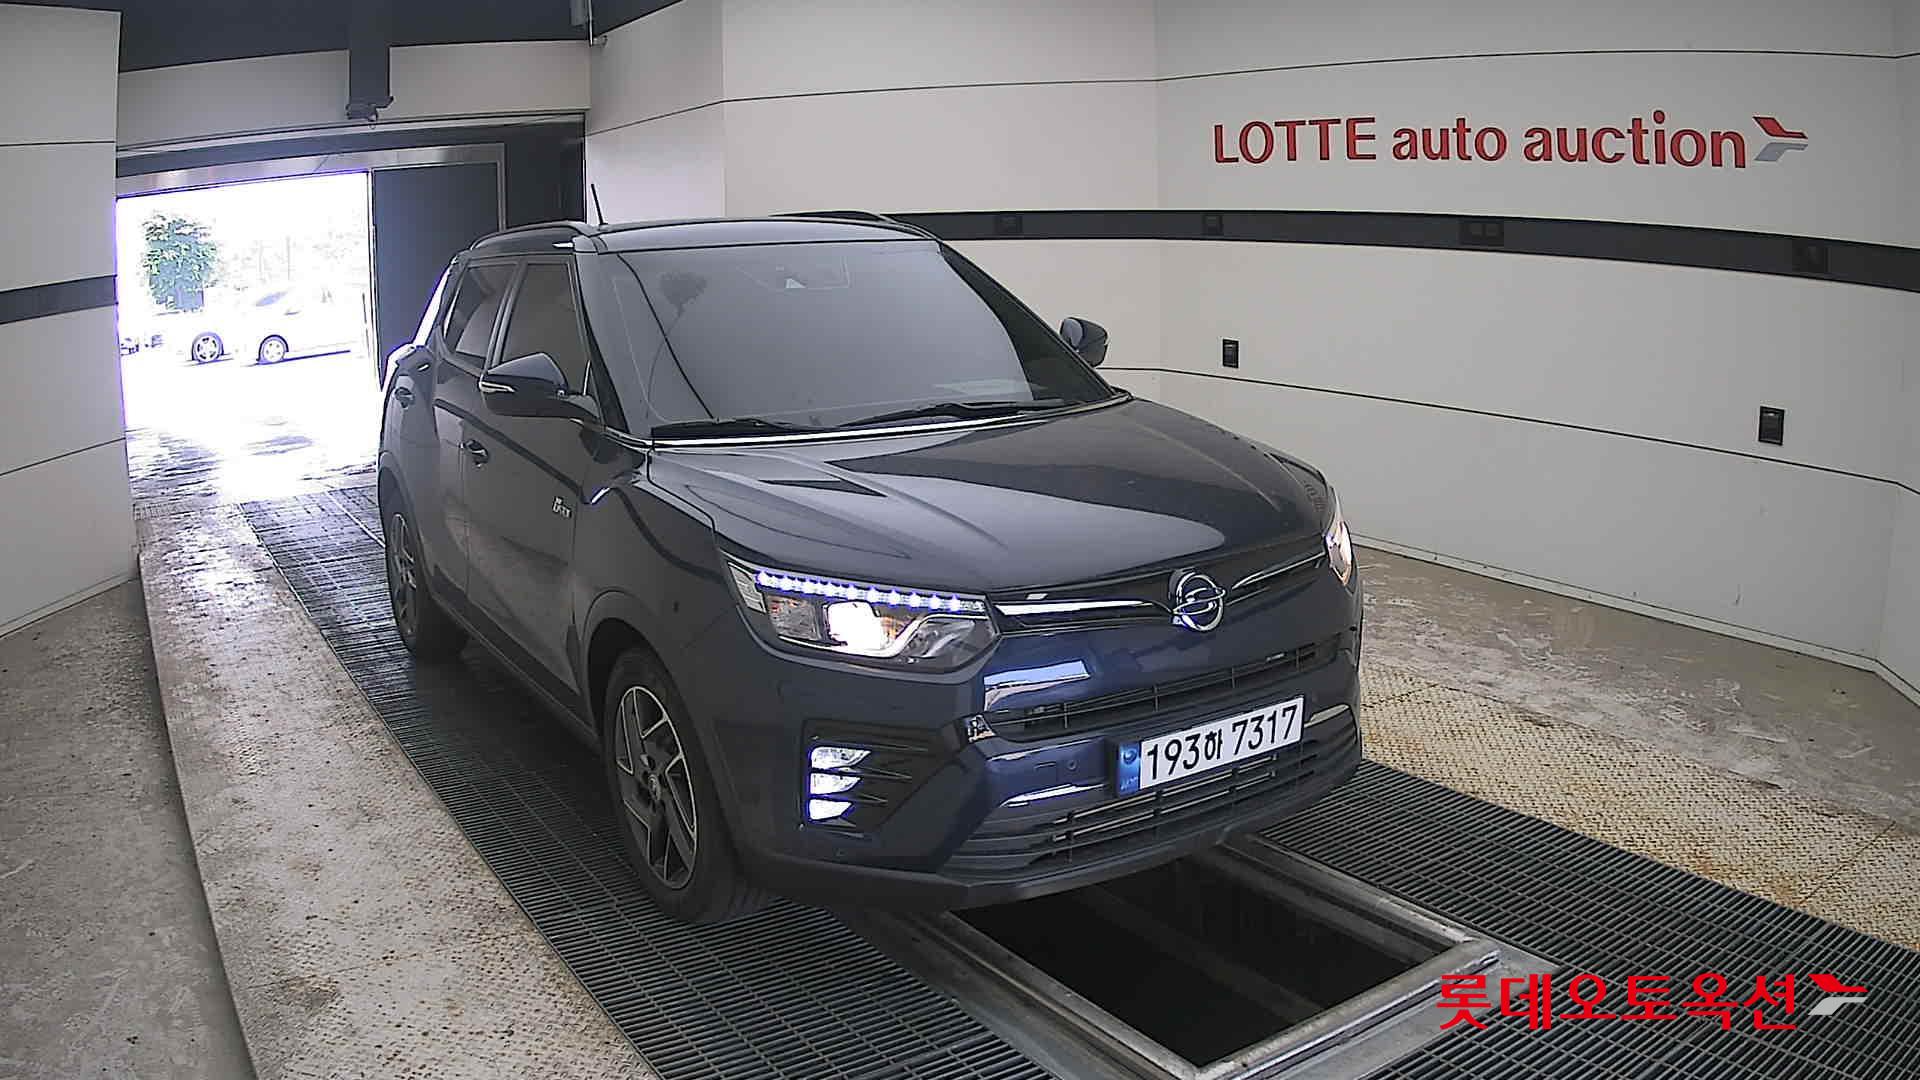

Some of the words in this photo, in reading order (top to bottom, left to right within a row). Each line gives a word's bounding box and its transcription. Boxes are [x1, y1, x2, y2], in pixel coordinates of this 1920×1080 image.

[1213, 117, 1377, 163] LOTTE
[1392, 117, 1508, 161] auto
[1523, 109, 1747, 169] auction
[1146, 728, 1224, 780] 193하
[1231, 704, 1298, 756] 7317
